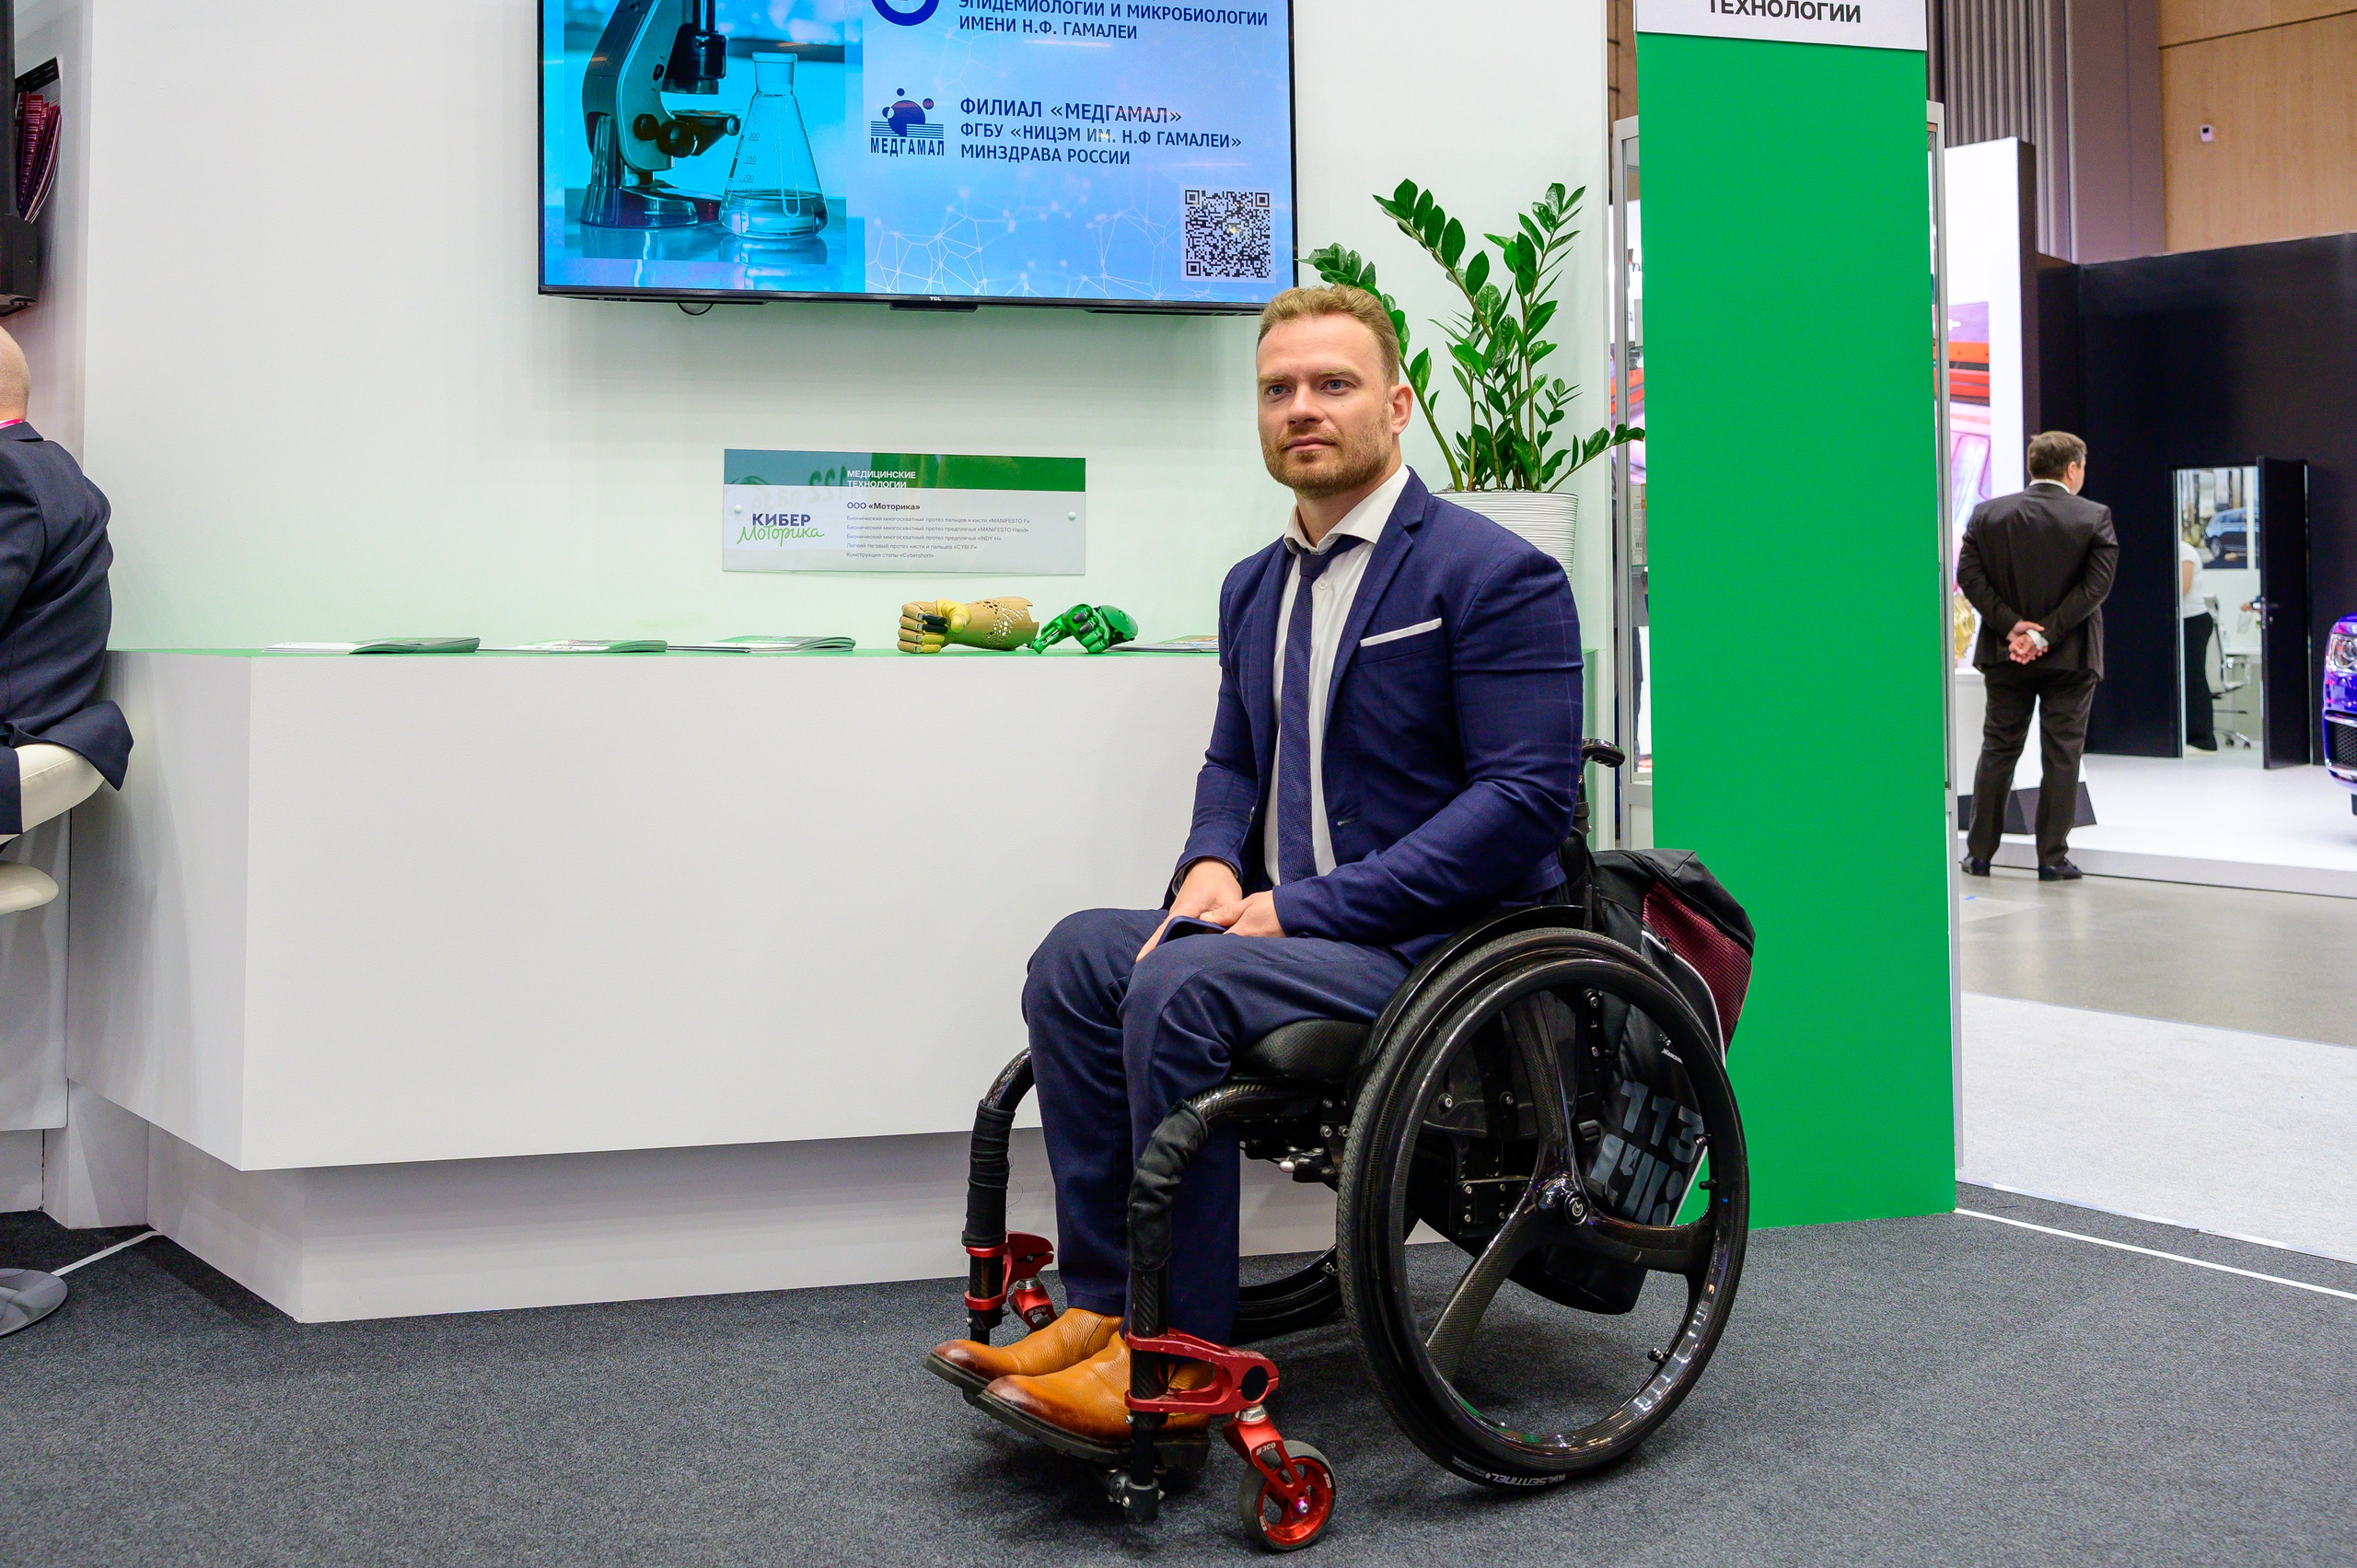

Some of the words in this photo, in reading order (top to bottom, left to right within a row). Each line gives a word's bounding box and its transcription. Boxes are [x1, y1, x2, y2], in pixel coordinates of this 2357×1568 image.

[958, 0, 1105, 17] ЭПИДЕМИОЛОГИИ
[1110, 3, 1121, 17] И
[1127, 4, 1268, 27] МИКРОБИОЛОГИИ
[1710, 0, 1861, 23] ТЕХНОЛОГИИ
[959, 15, 1016, 32] ИМЕНИ
[1023, 19, 1057, 34] Н.Ф.
[1063, 21, 1137, 39] ГАМАЛЕИ
[960, 98, 1041, 118] ФИЛИАЛ
[1051, 103, 1181, 123] «МЕДГАМАЛ»
[960, 122, 1004, 138] ФГБУ
[1011, 125, 1080, 143] «НИЦЭМ
[1086, 128, 1116, 143] ИМ.
[1122, 129, 1151, 145] Н.Ф
[1157, 131, 1241, 148] ГАМАЛЕИ»
[870, 137, 945, 157] МЕДГАМАЛ
[961, 144, 1062, 163] МИНЗДРАВА
[1068, 148, 1130, 165] РОССИИ
[847, 470, 916, 479] МЕДИЦИНСКИЕ
[847, 480, 907, 488] ТЕХНОЛОГИИ
[868, 502, 921, 511] «Моторика»
[752, 513, 811, 527] КИБЕР
[1491, 1473, 1549, 1486] SENTINEL
